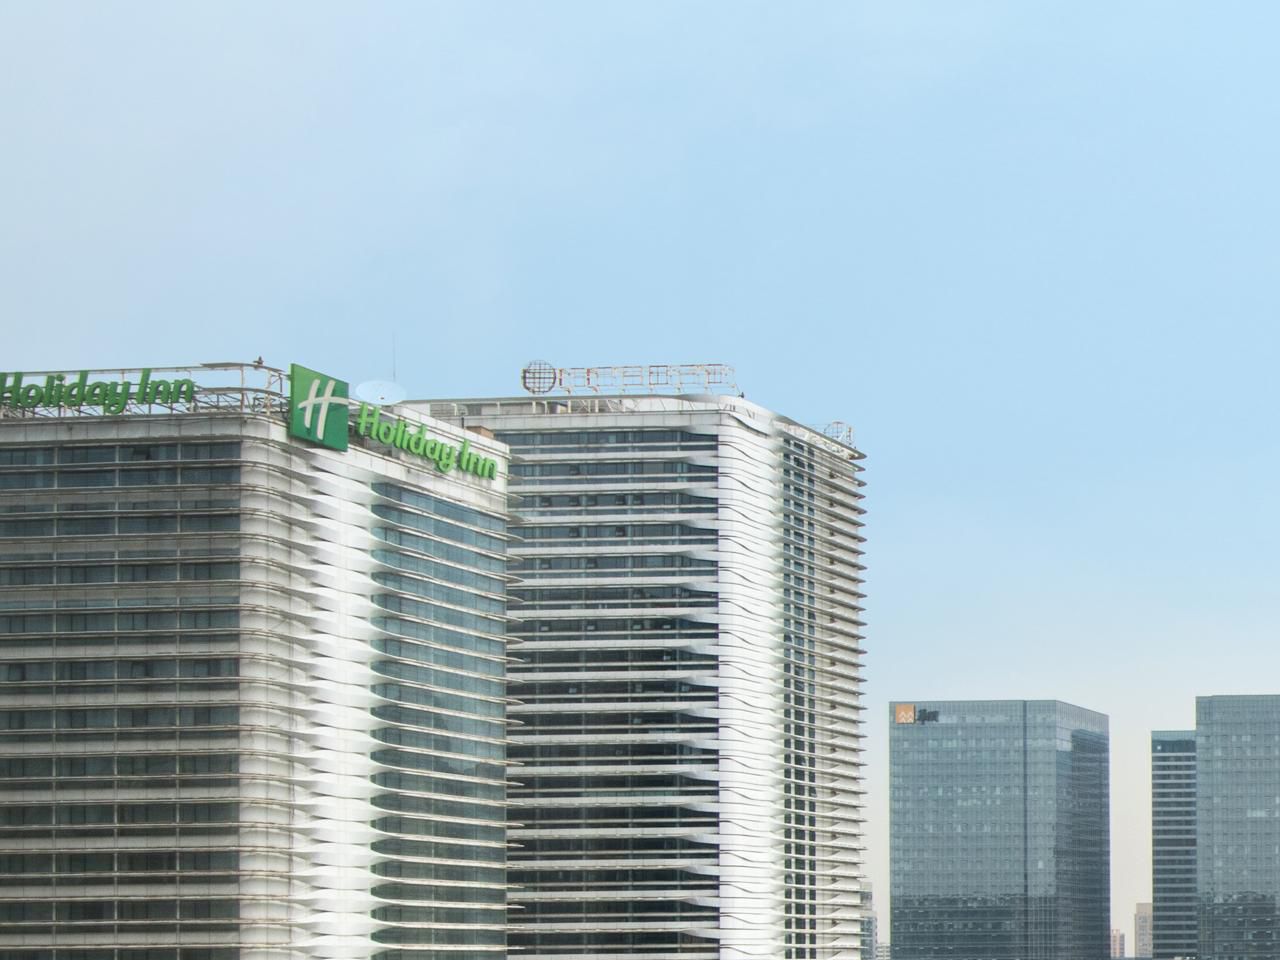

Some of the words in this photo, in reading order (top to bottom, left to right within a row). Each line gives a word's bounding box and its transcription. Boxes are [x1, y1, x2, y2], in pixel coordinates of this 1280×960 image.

[0, 368, 131, 414] Holiday
[136, 368, 195, 404] Inn
[357, 403, 456, 473] Holiday
[460, 439, 498, 480] Inn
